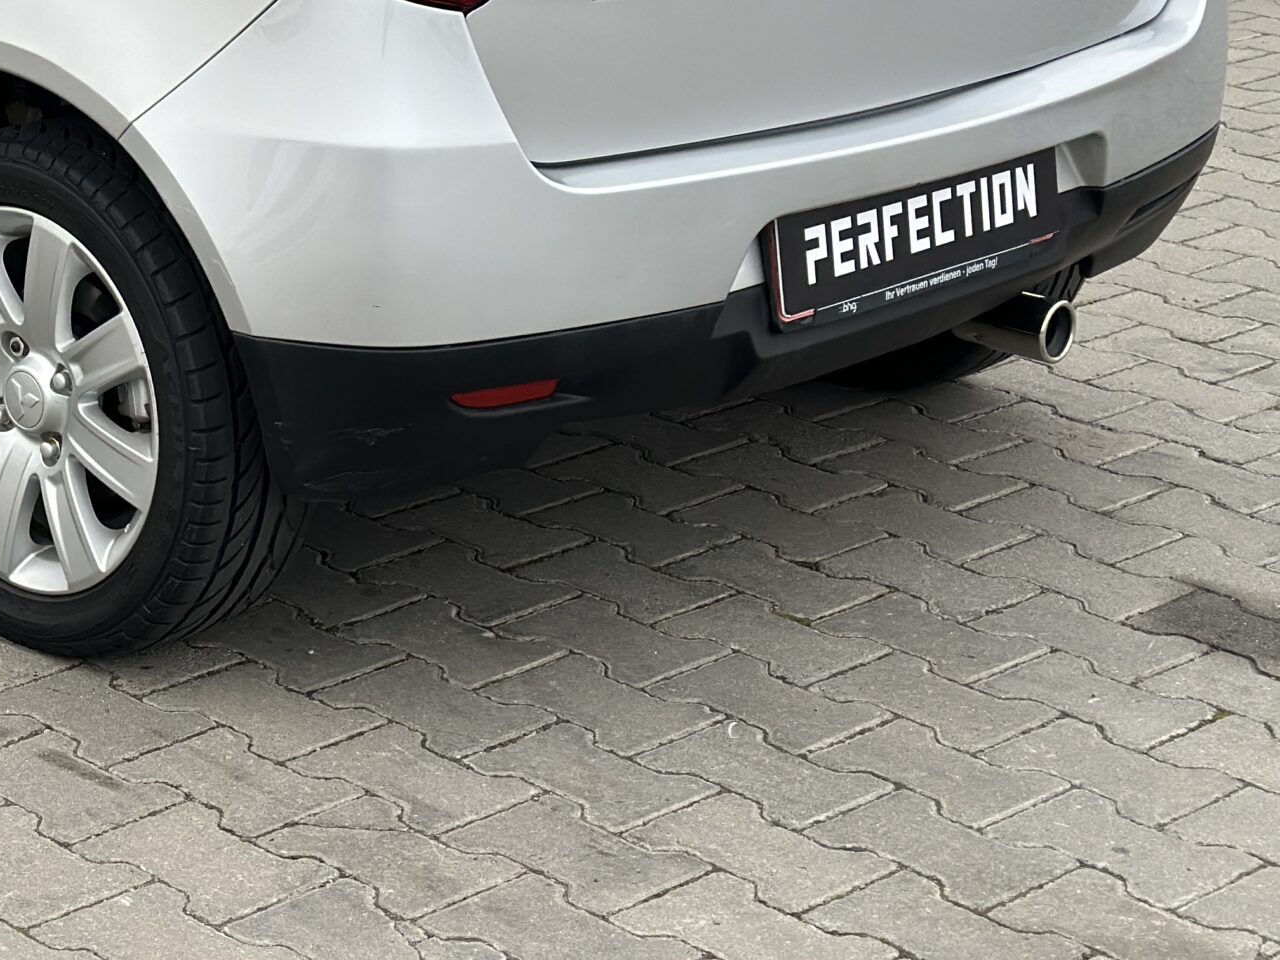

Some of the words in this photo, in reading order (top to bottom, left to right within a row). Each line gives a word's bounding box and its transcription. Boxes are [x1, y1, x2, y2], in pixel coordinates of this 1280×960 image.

[804, 163, 1038, 286] PERFECTION
[885, 290, 895, 301] Ihr
[896, 280, 928, 298] Vertrauen
[929, 270, 961, 287] verdienen
[966, 261, 985, 277] jeden
[985, 257, 998, 269] Tag!
